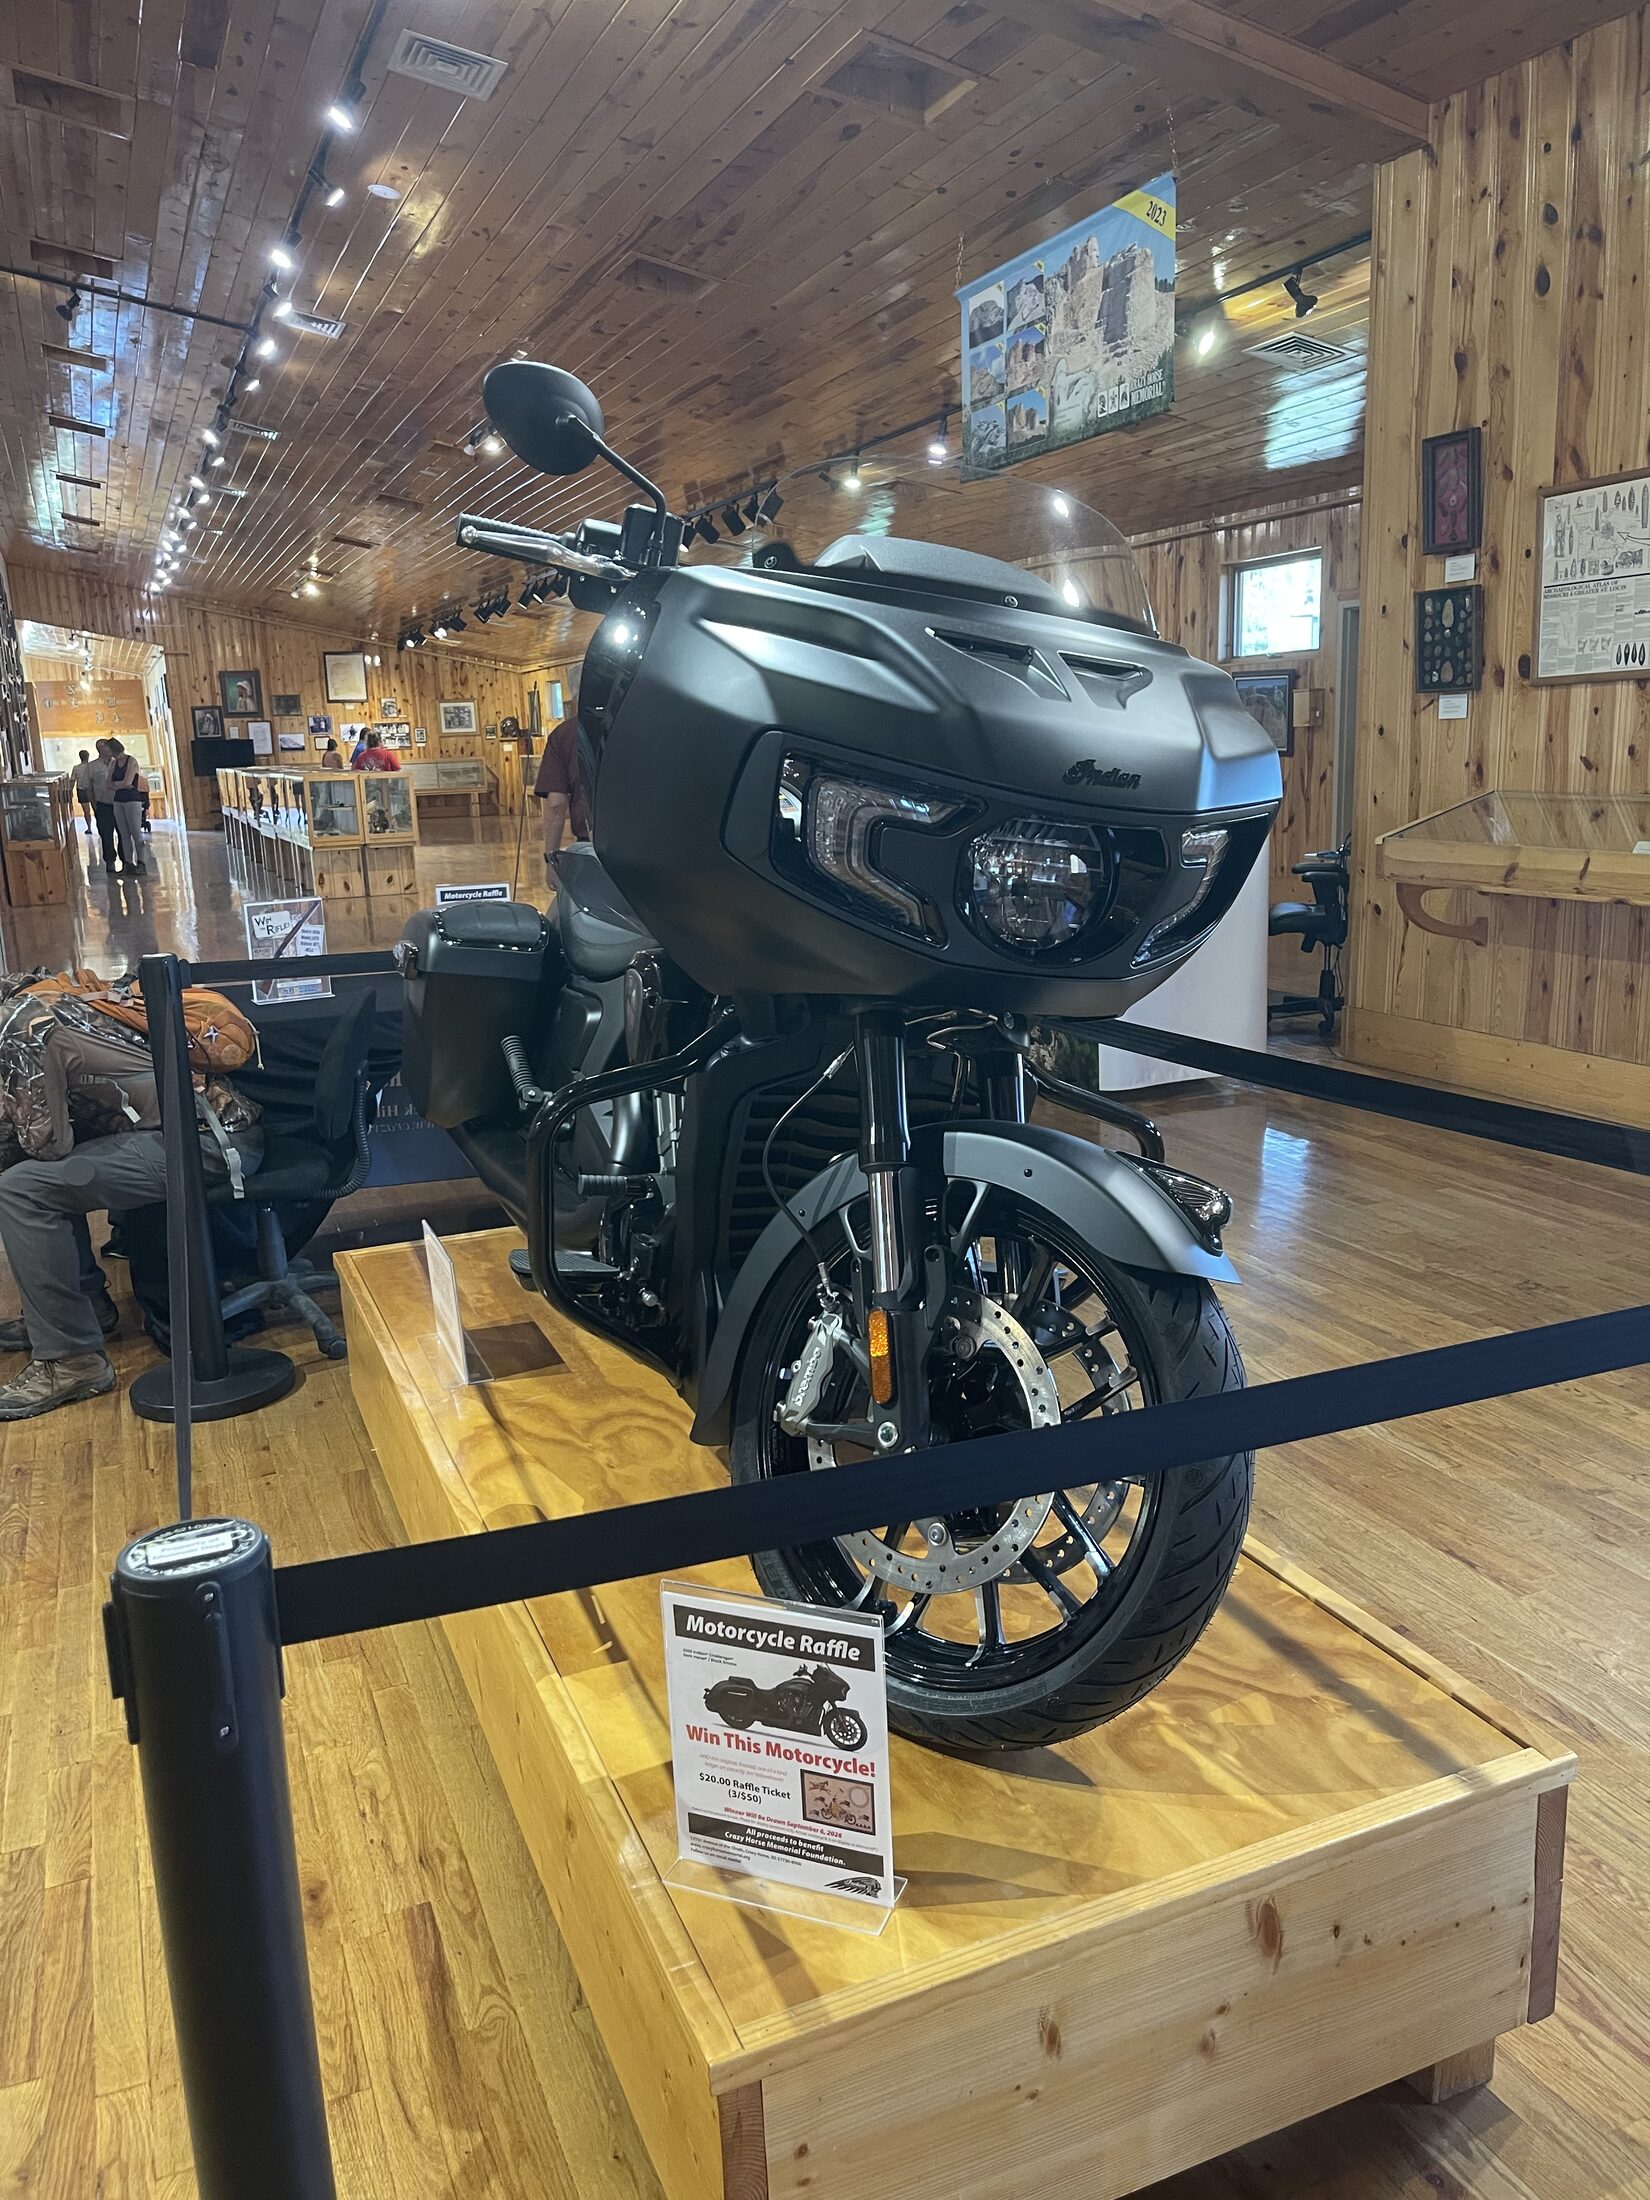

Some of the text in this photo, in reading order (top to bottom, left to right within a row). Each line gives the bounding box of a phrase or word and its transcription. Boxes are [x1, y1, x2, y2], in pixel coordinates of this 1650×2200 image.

[1146, 200, 1167, 227] 2023
[1593, 581, 1610, 589] ATLAS
[1062, 758, 1141, 790] Indian
[444, 889, 503, 900] Motorcycle Raffle
[792, 1346, 821, 1407] brembo
[686, 1614, 861, 1662] Motorcycle Raffle
[686, 1724, 876, 1778] Win This Motorcycle!
[699, 1772, 791, 1800] $20.00 Raffle Ticket
[728, 1789, 762, 1805] (3/$50)
[724, 1807, 745, 1816] Winner
[766, 1816, 786, 1826] Drawn
[787, 1820, 819, 1833] September
[725, 1831, 745, 1843] Crazy
[745, 1836, 766, 1847] Horse
[767, 1841, 801, 1855] Memorial
[801, 1848, 846, 1866] Foundation.
[746, 1828, 757, 1836] All
[757, 1831, 789, 1844] proceeds
[789, 1837, 798, 1845] to
[798, 1838, 824, 1852] benefit
